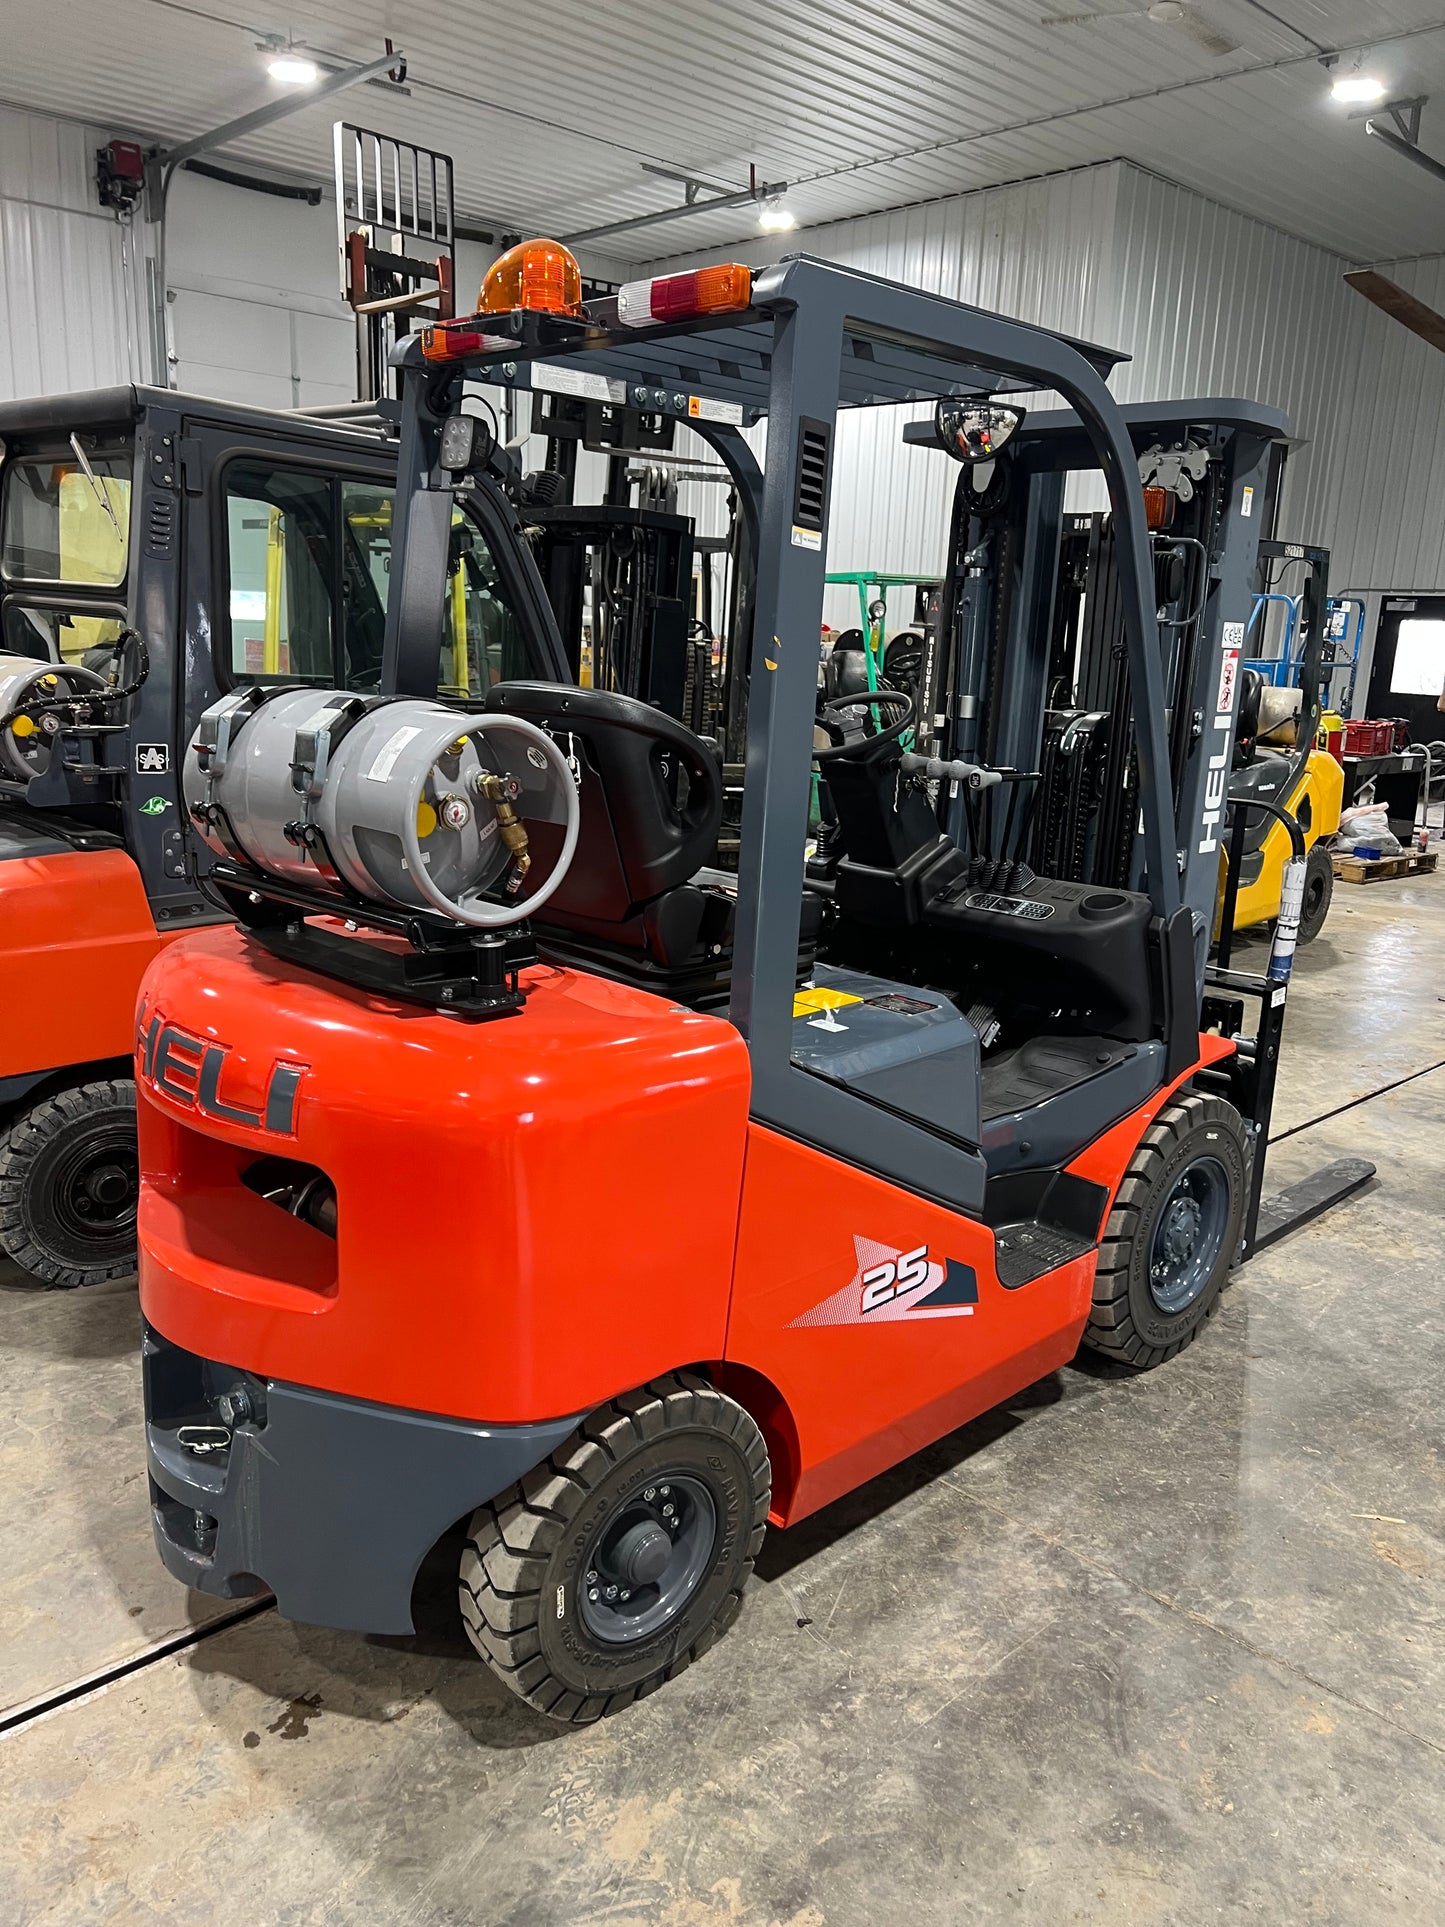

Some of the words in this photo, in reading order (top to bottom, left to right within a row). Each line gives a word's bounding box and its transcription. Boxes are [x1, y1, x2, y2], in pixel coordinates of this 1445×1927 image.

[923, 636, 935, 714] MITSUBISHI
[1198, 715, 1232, 854] HELI
[136, 1000, 301, 1135] HELI
[860, 1244, 929, 1314] 25
